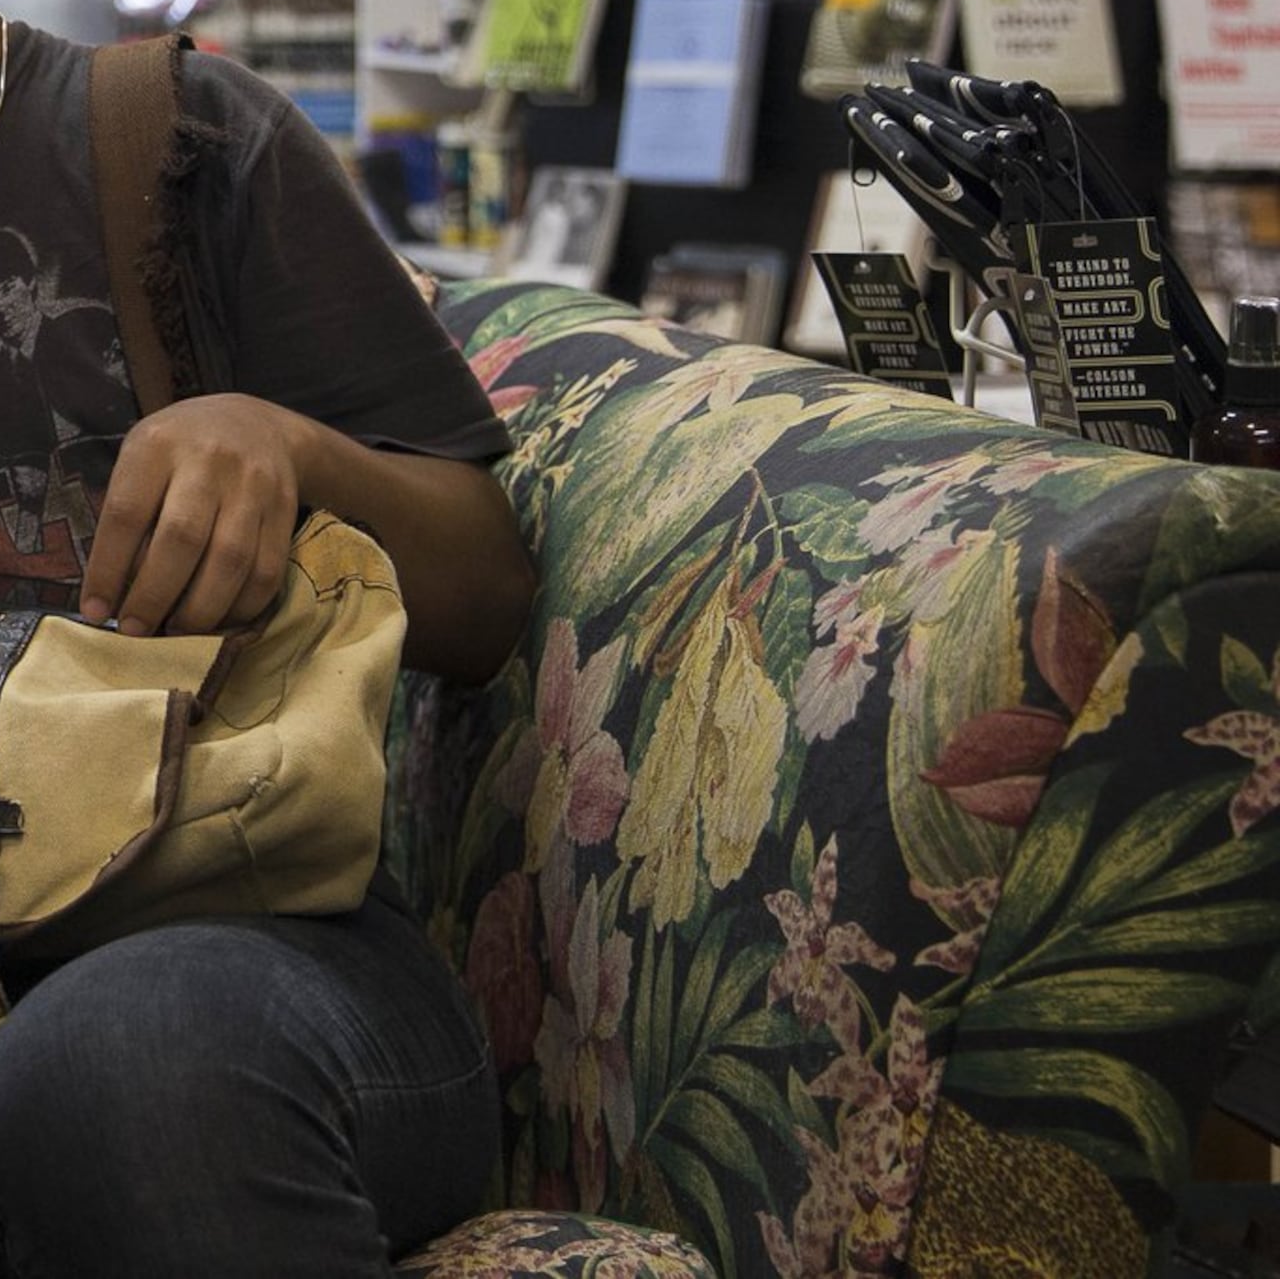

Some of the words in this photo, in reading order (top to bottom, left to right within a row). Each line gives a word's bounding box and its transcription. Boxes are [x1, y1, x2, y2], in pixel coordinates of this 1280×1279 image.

[1076, 259, 1109, 272] KIND
[1112, 257, 1130, 270] TO
[1057, 273, 1134, 289] EVERYBODY.
[1062, 302, 1099, 316] MAKE
[1103, 300, 1132, 315] ART.
[1065, 328, 1105, 342] FIGHT
[1108, 326, 1135, 340] THE
